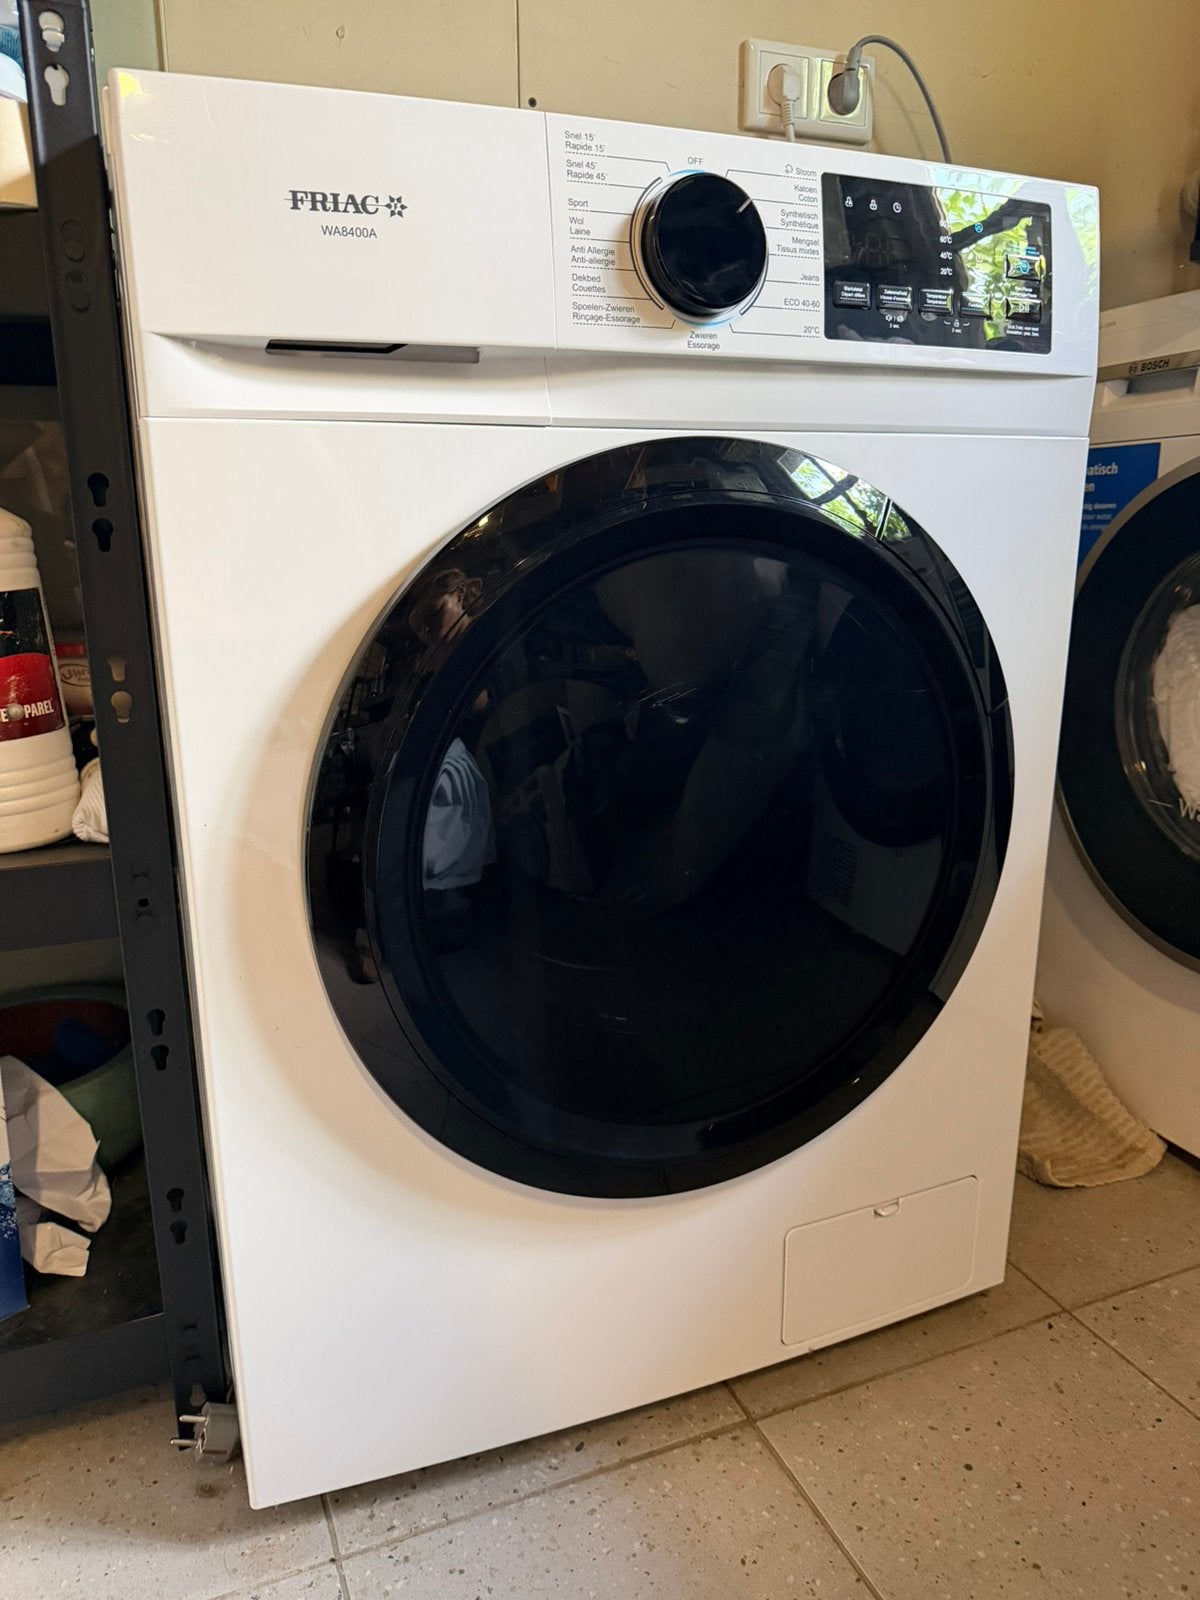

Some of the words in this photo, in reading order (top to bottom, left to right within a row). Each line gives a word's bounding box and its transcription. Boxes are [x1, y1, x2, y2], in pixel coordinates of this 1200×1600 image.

[564, 130, 582, 140] Snel
[565, 141, 592, 152] Rapide
[566, 159, 584, 168] Snel
[687, 156, 704, 166] OFF
[566, 170, 594, 180] Rapide
[796, 168, 817, 177] Stoom
[794, 184, 818, 194] Katoen
[288, 189, 379, 215] FRIAC
[568, 198, 589, 208] Sport
[798, 194, 818, 203] Coton
[780, 208, 818, 220] Synthetisch
[569, 216, 584, 224] Wol
[320, 224, 378, 238] WA8400A
[570, 226, 591, 236] Laine
[792, 236, 820, 247] Mengsel
[570, 245, 586, 254] Anti
[587, 246, 616, 257] Allergie
[776, 244, 797, 254] Tissus
[570, 255, 616, 267] Anti-allergie
[572, 274, 601, 282] Dekbed
[800, 273, 820, 282] Jeans
[572, 284, 606, 293] Couettes
[572, 302, 635, 312] Spoelen-Zwieren
[784, 298, 800, 306] ECO
[802, 298, 820, 308] 40-60
[572, 312, 640, 324] Rinçage-Essorage
[690, 330, 718, 340] Zwieren
[803, 326, 820, 334] 20°C
[688, 340, 720, 351] Essorage
[1140, 358, 1170, 372] BOSCH
[1086, 462, 1118, 476] atisch
[0, 708, 9, 723] E
[23, 699, 54, 718] PAREL
